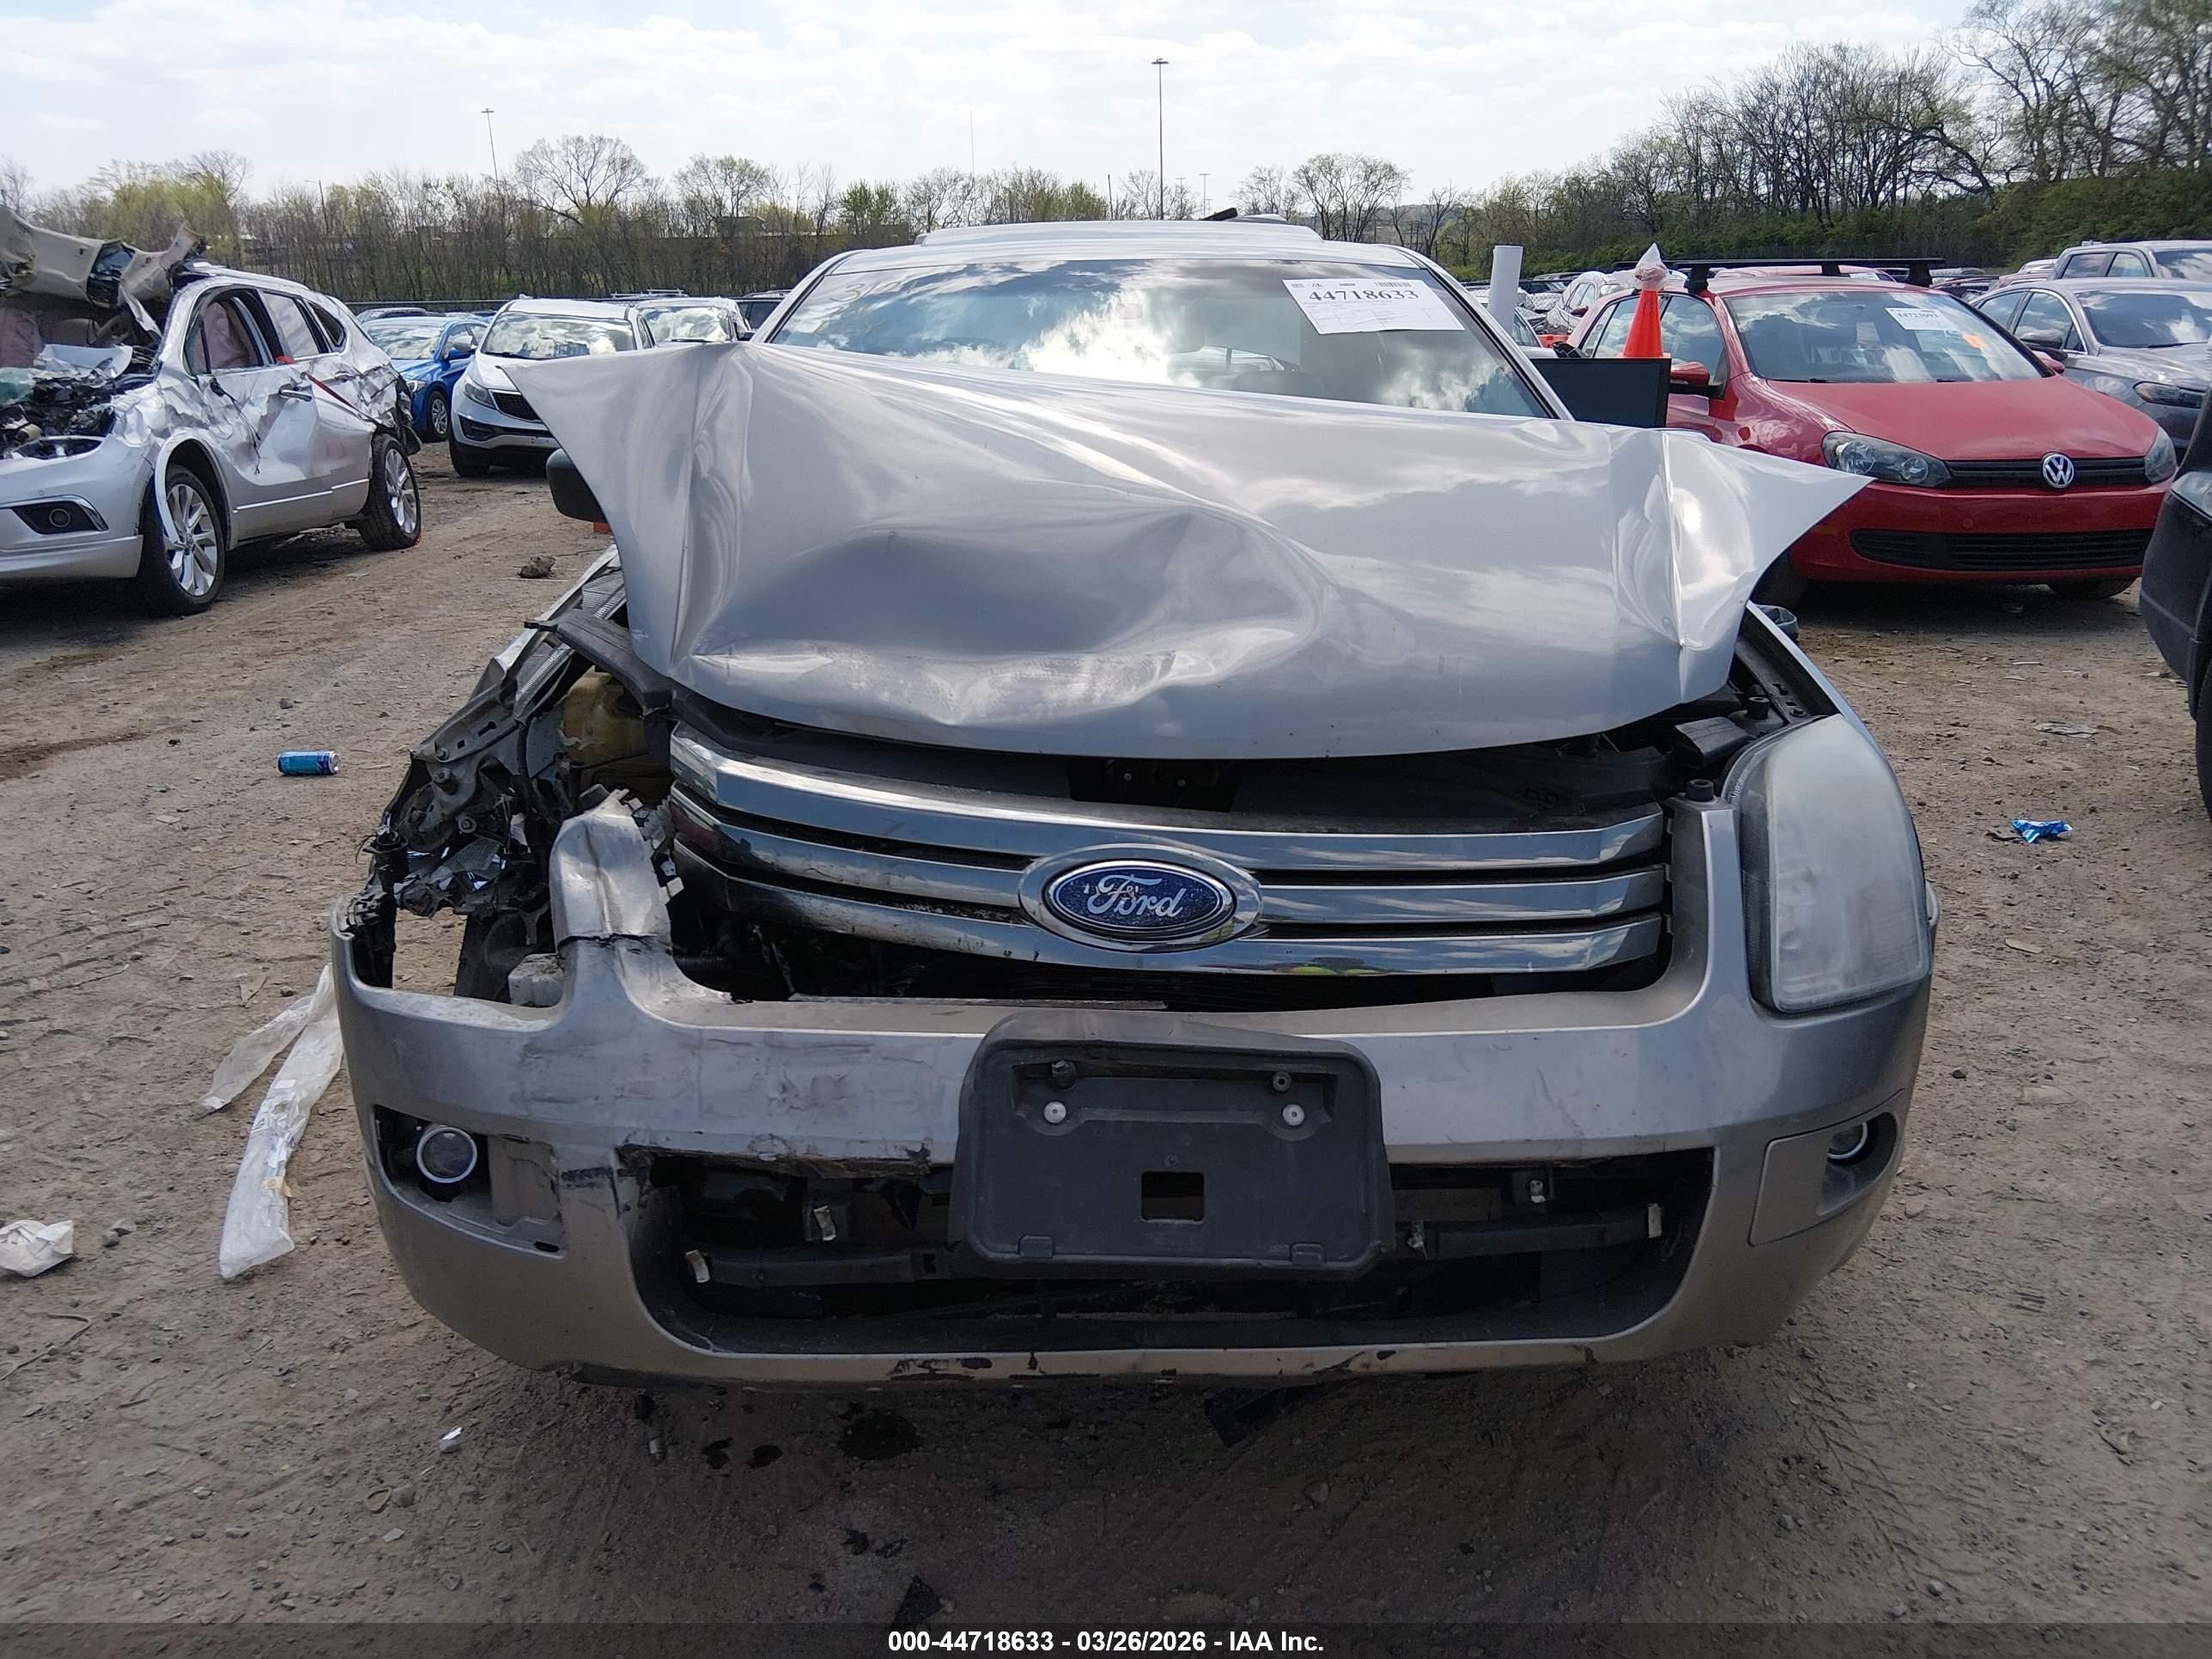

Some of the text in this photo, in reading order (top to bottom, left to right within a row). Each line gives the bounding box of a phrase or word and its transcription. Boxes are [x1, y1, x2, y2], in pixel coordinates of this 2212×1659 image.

[1309, 289, 1419, 301] 44718633
[2045, 455, 2073, 486] VW
[1085, 874, 1187, 917] Ford
